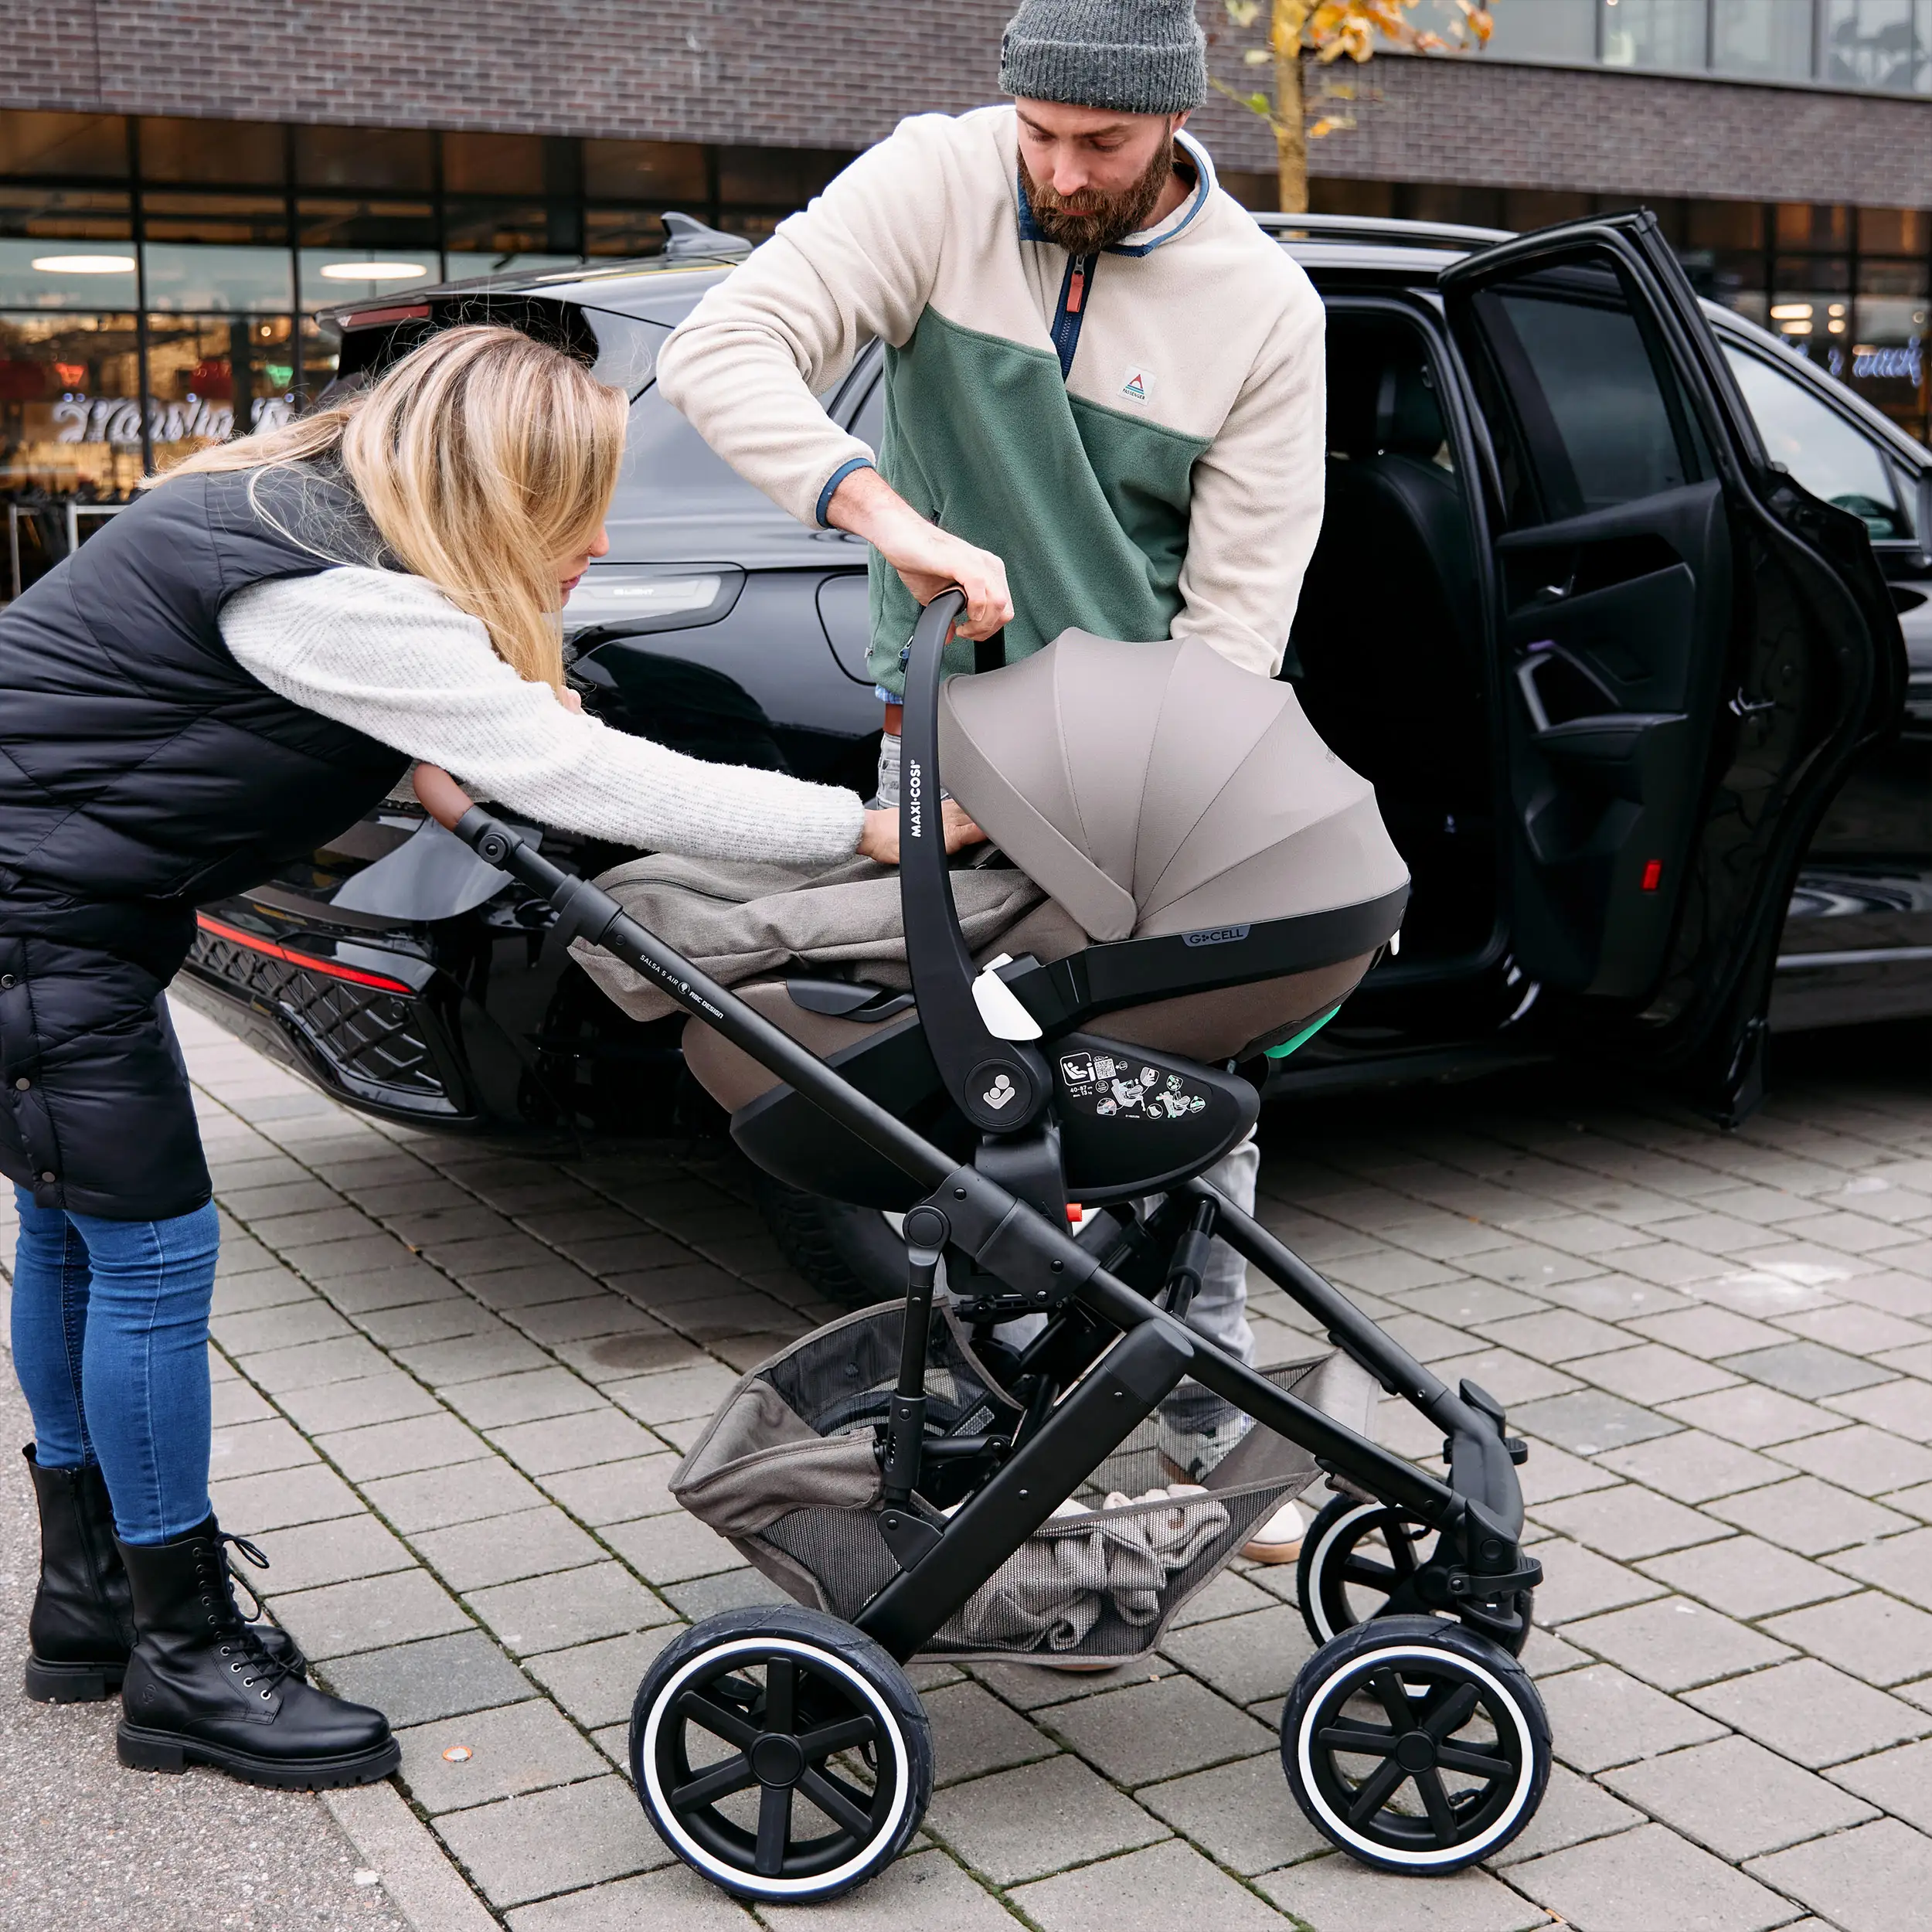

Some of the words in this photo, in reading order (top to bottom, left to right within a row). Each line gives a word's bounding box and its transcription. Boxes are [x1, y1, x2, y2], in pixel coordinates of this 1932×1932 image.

[1123, 388, 1145, 400] PASSENGER
[640, 954, 660, 972] SALSA
[666, 975, 679, 985] AIR
[689, 991, 703, 1003] ABC
[701, 1001, 724, 1019] DESIGN
